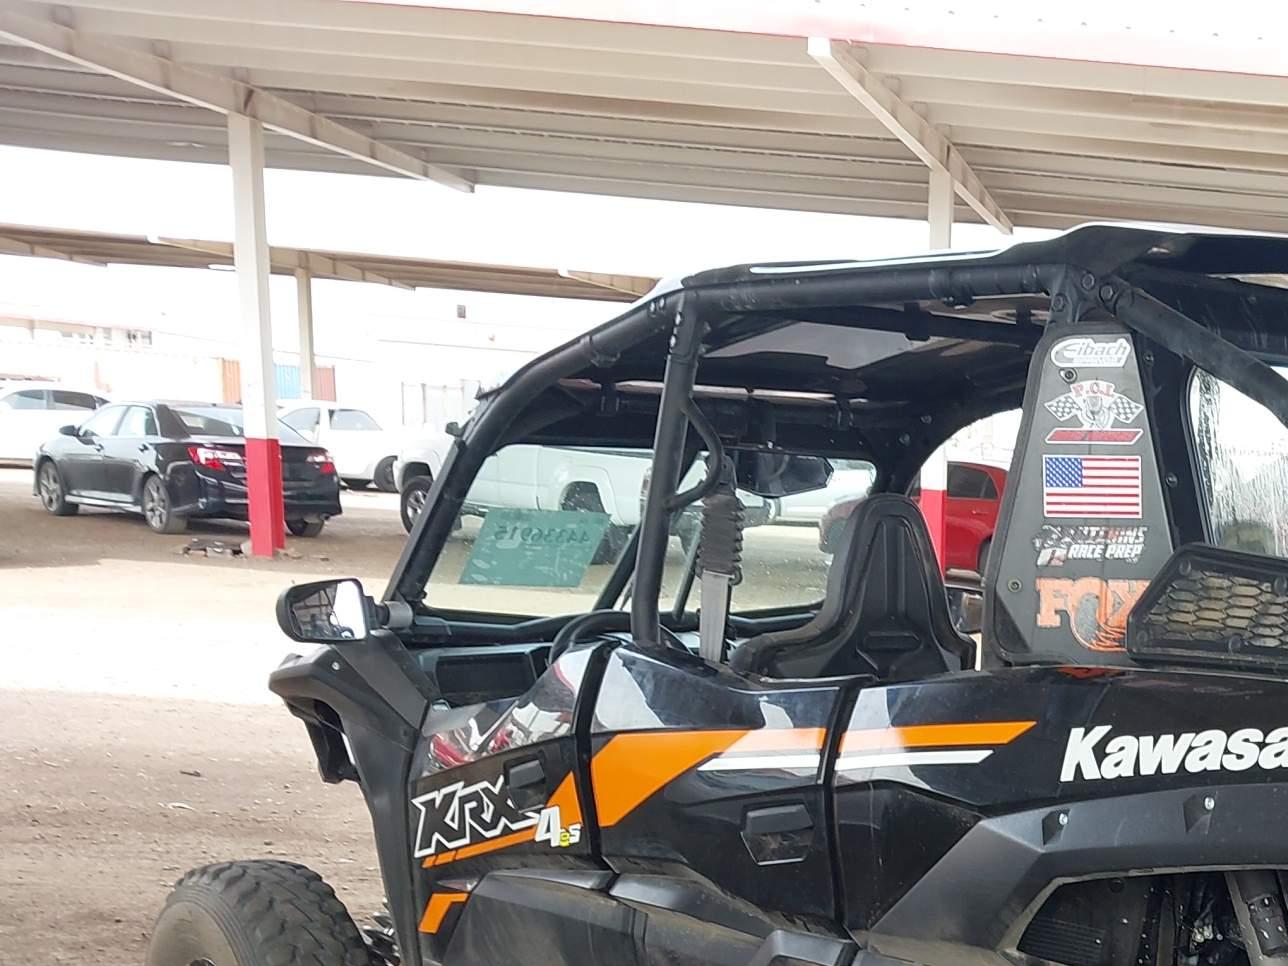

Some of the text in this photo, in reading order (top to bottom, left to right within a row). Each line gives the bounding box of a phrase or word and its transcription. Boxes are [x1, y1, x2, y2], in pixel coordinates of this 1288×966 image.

[1053, 340, 1129, 363] Eibach
[1068, 543, 1145, 559] RACE PREP
[1035, 577, 1152, 652] FOX
[410, 774, 540, 858] KRX
